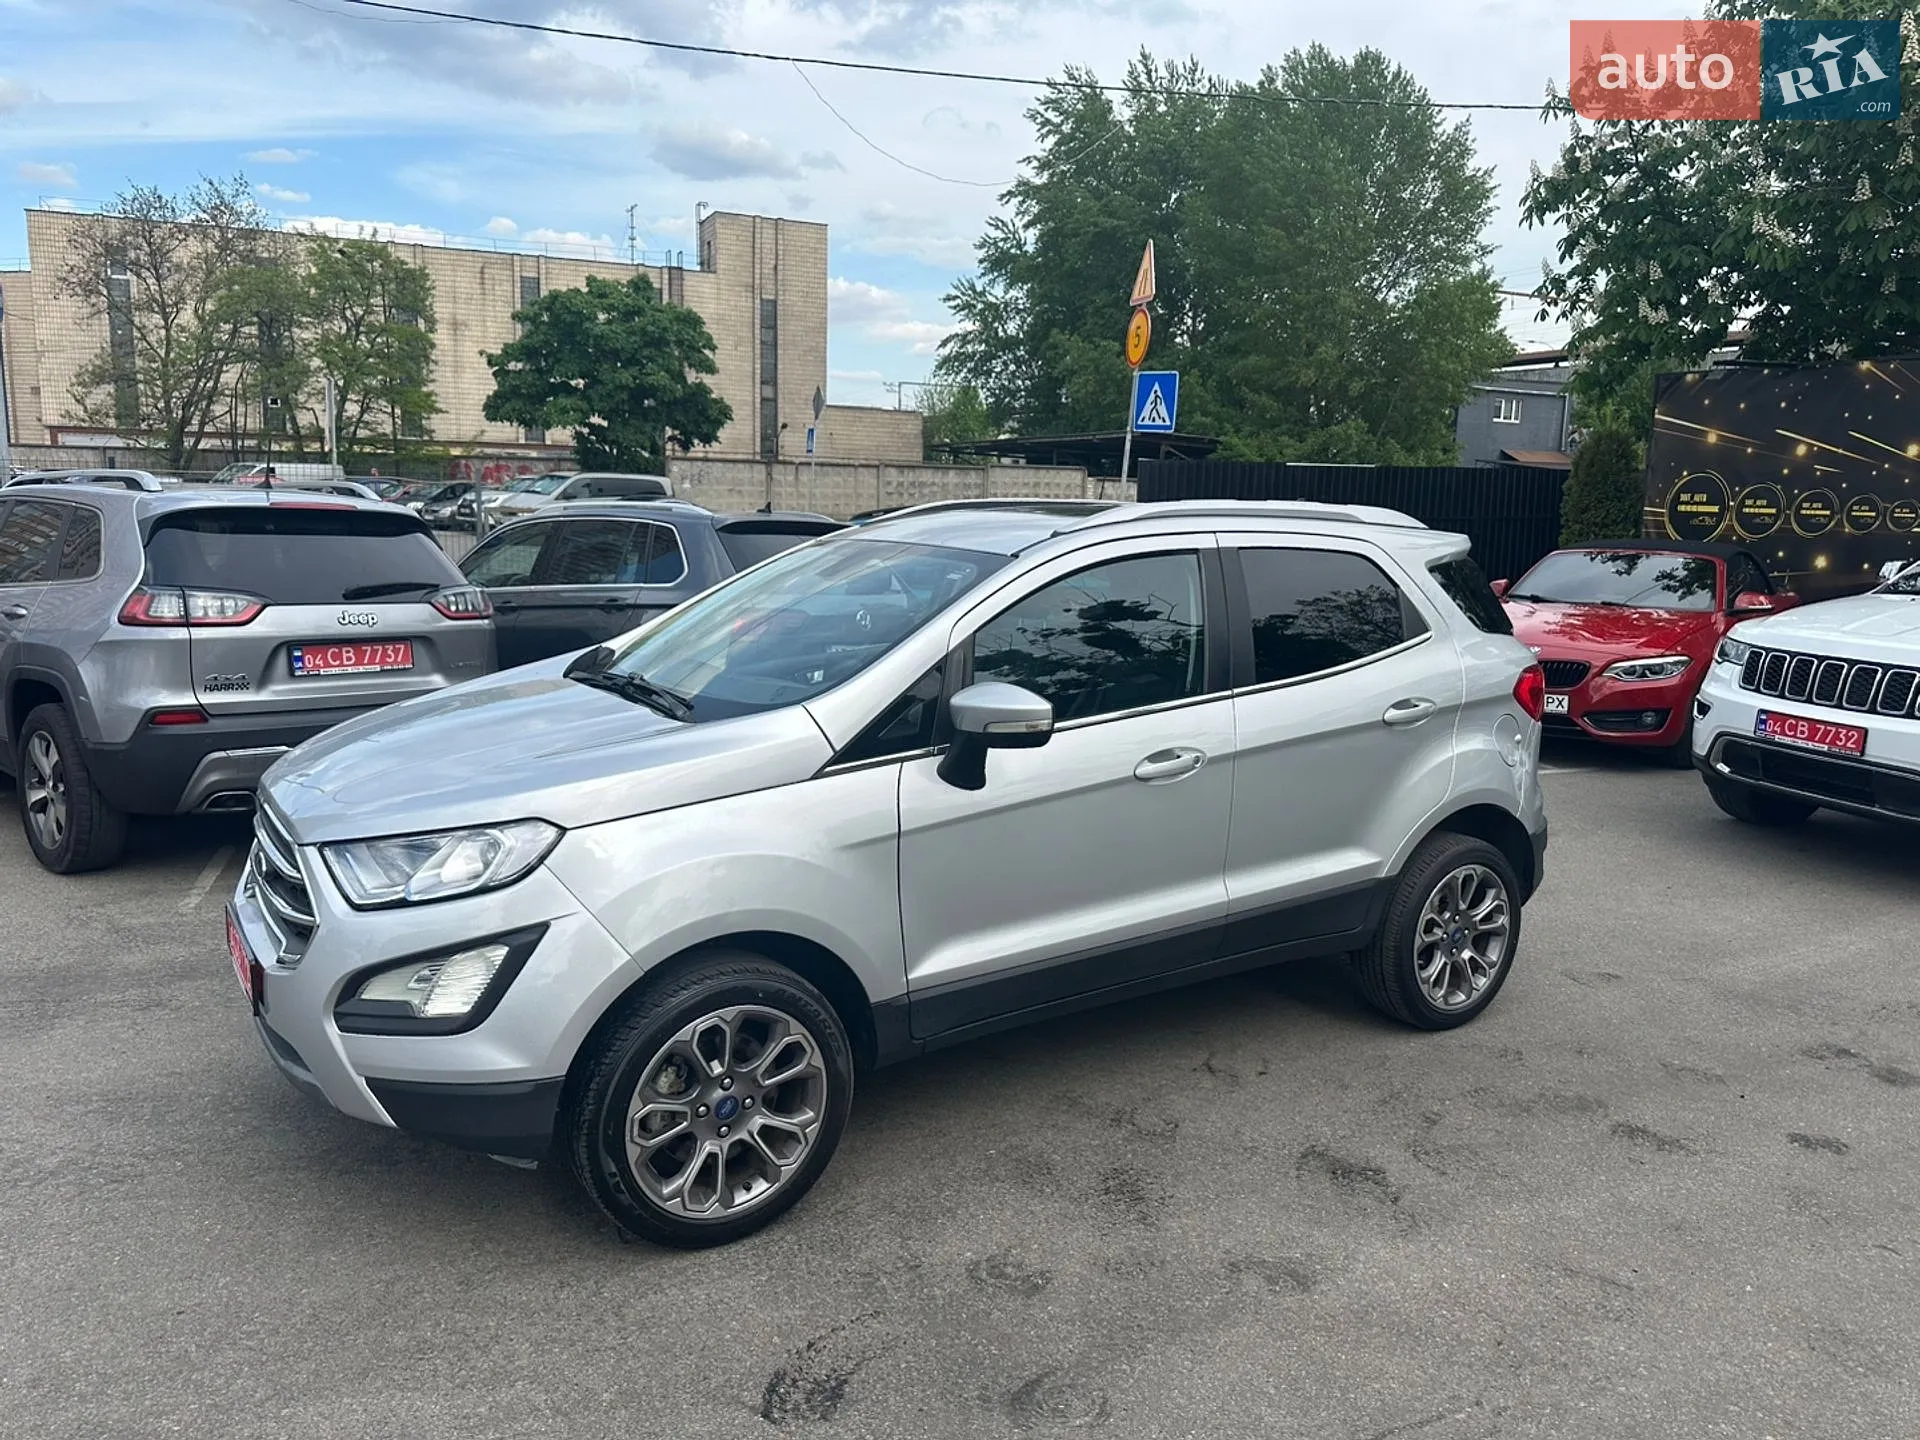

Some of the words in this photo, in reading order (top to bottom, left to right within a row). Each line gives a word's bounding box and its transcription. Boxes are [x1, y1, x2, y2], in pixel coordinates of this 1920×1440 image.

[1133, 326, 1141, 347] 5
[337, 610, 378, 627] Jeep
[304, 654, 324, 668] 04
[327, 647, 355, 666] CB
[361, 644, 405, 664] 7737
[1546, 696, 1565, 709] PX
[1766, 720, 1781, 734] 04
[1784, 719, 1809, 738] CB
[1814, 724, 1858, 748] 7732
